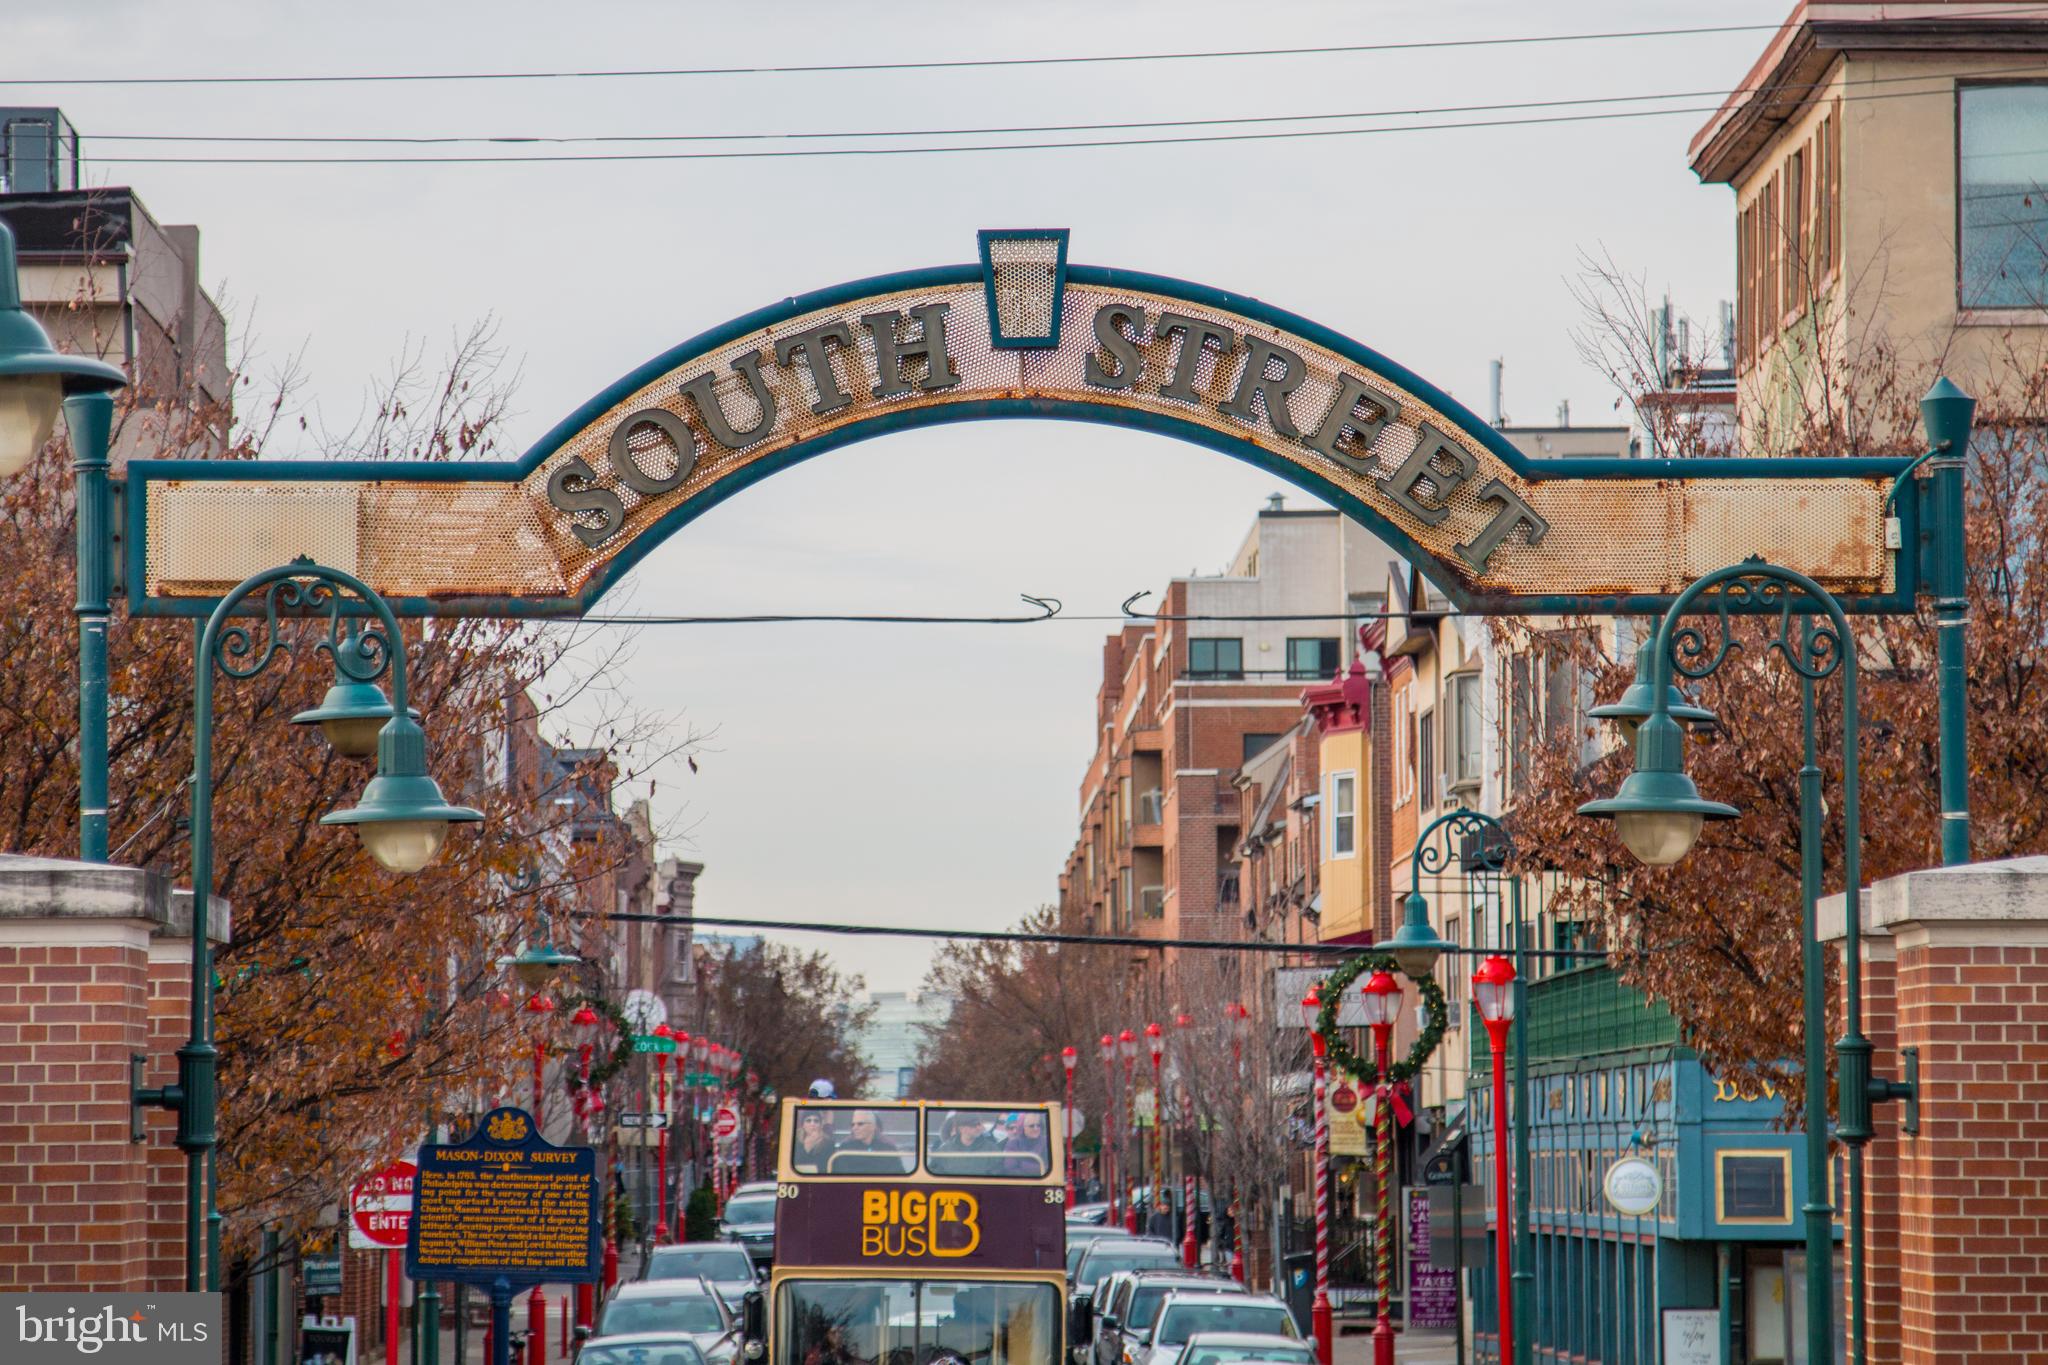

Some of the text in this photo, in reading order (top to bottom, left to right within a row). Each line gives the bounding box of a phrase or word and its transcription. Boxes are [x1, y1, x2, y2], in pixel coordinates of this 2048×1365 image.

[547, 302, 1551, 575] SOUTH STREET
[435, 1150, 577, 1163] MASON-DIXON SURVEY
[447, 1172, 456, 1180] in
[480, 1172, 494, 1181] the
[496, 1173, 553, 1182] southernmost
[556, 1174, 578, 1183] point
[580, 1173, 590, 1183] of
[392, 1176, 413, 1192] NO
[421, 1179, 473, 1189] Philadelphia
[491, 1181, 538, 1190] determined
[550, 1182, 563, 1190] the
[421, 1188, 435, 1197] ing
[438, 1188, 461, 1198] point
[465, 1189, 478, 1197] for
[482, 1190, 495, 1198] the
[498, 1191, 529, 1200] survey
[532, 1190, 542, 1199] of
[563, 1191, 574, 1199] of
[777, 1184, 799, 1199] 80
[1045, 1189, 1065, 1204] 38
[421, 1197, 442, 1205] most
[446, 1198, 490, 1207] important
[493, 1198, 527, 1206] borders
[530, 1199, 538, 1207] in
[542, 1199, 557, 1207] the
[863, 1190, 927, 1224] BIG
[420, 1205, 452, 1214] Charles
[483, 1206, 499, 1214] and
[502, 1206, 540, 1215] Jeremiah
[542, 1206, 567, 1216] Dixon
[569, 1207, 588, 1216] took
[369, 1216, 411, 1230] ENTE
[463, 1214, 524, 1223] measurements
[527, 1216, 537, 1224] of
[547, 1216, 576, 1226] degree
[578, 1217, 589, 1225] of
[454, 1223, 492, 1232] elevating
[494, 1224, 545, 1233] professional
[546, 1225, 589, 1235] surveying
[464, 1231, 478, 1239] The
[478, 1233, 507, 1242] survey
[507, 1232, 532, 1241] ended
[540, 1233, 558, 1242] land
[559, 1234, 588, 1243] dispute
[862, 1226, 926, 1257] BUS
[446, 1240, 455, 1248] by
[458, 1240, 487, 1248] William
[488, 1240, 508, 1248] Penn
[510, 1240, 524, 1249] and
[524, 1240, 545, 1249] Lord
[419, 1247, 451, 1256] Western
[465, 1248, 492, 1257] Indian
[512, 1249, 528, 1258] and
[556, 1250, 588, 1259] weather
[418, 1255, 451, 1266] delayed
[453, 1256, 498, 1266] completion
[500, 1256, 510, 1266] of
[511, 1257, 525, 1266] the
[527, 1258, 542, 1266] line
[545, 1258, 565, 1266] until
[1417, 1276, 1454, 1287] TAXES
